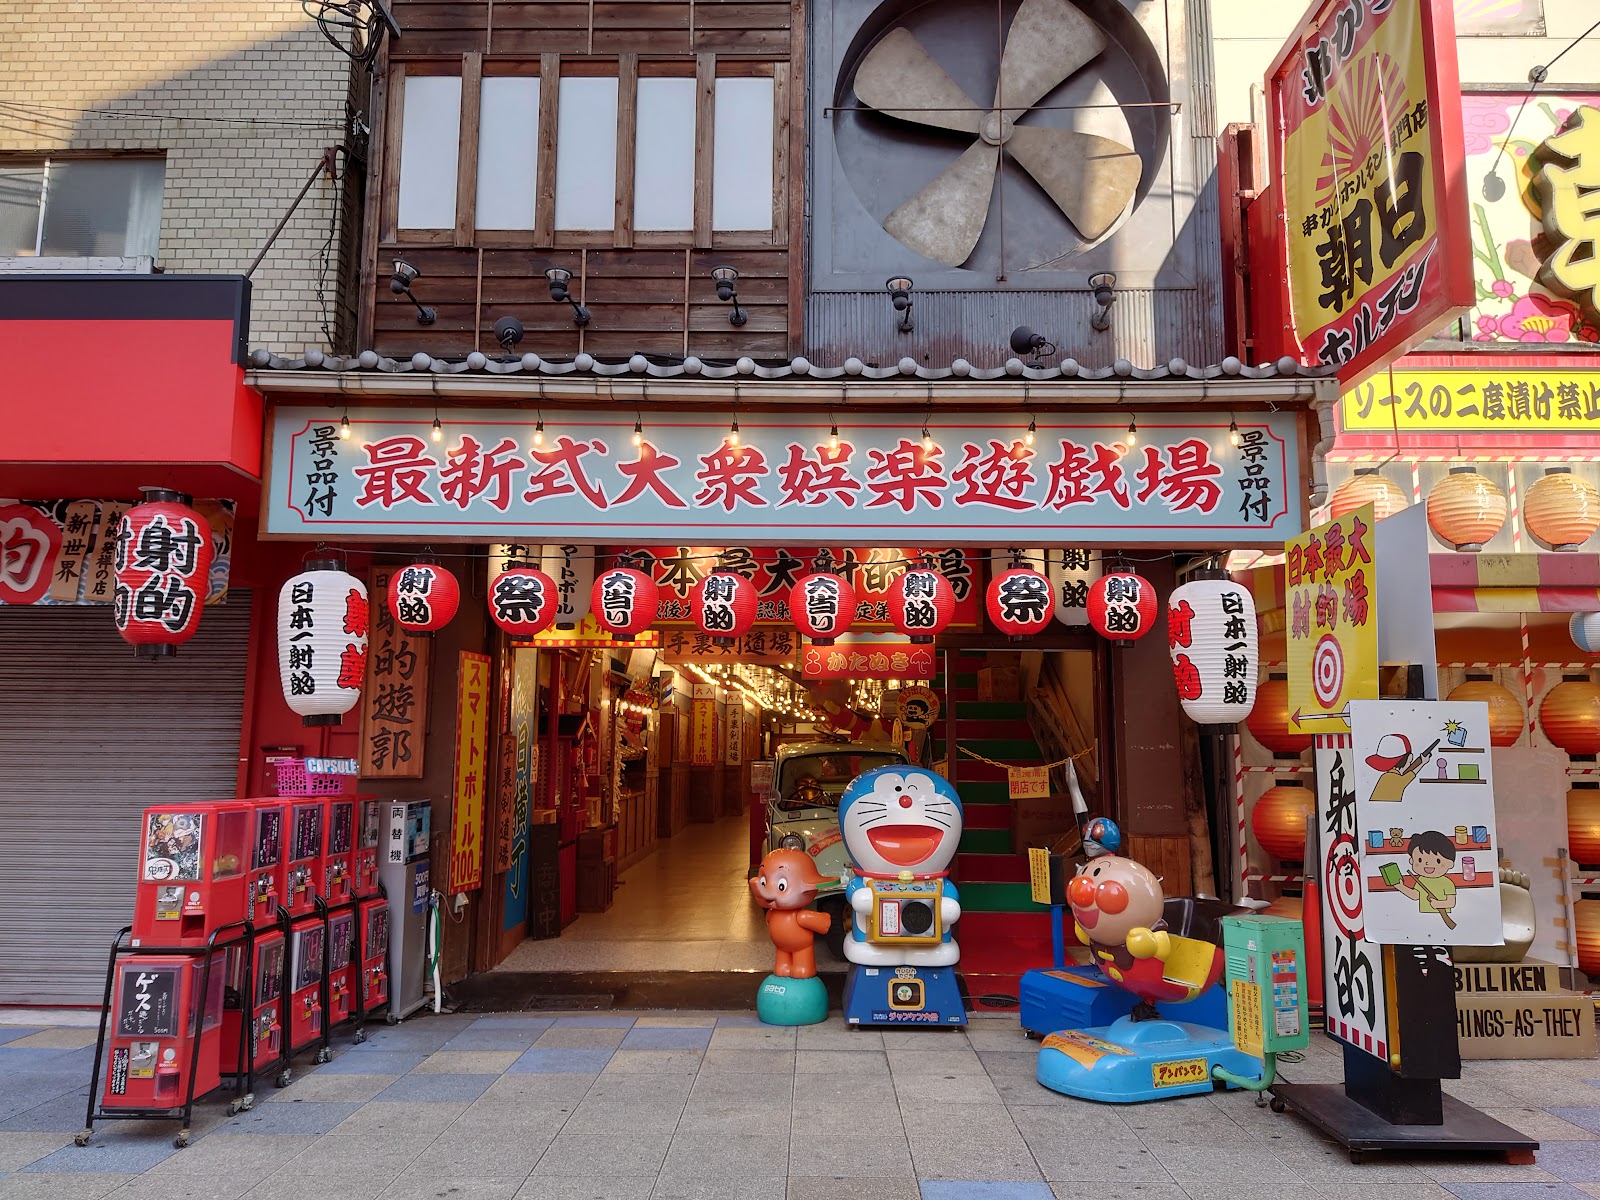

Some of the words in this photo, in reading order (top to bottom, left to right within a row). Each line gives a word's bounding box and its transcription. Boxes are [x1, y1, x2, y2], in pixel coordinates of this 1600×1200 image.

[1315, 151, 1426, 314] 朝日
[304, 425, 340, 517] 景品付
[353, 434, 1224, 515] 最新式大衆娯楽遊戯場
[1237, 430, 1271, 523] 景品付
[55, 512, 91, 583] 新世界
[134, 515, 203, 631] 射的
[1287, 515, 1372, 587] 日本最大
[399, 567, 435, 625] 射的
[494, 576, 544, 622] 祭
[603, 572, 635, 627] 大当り
[704, 576, 737, 631] 射的
[807, 577, 838, 631] 大当り
[904, 573, 937, 628] 射的
[1001, 575, 1049, 622] 祭
[1106, 577, 1140, 632] 射的
[1291, 568, 1369, 641] 射的場
[289, 581, 315, 695] 日本一射的
[827, 651, 910, 672] かたぬき
[1220, 591, 1248, 705] 日本一射的
[307, 758, 357, 774] CAPSULE
[461, 663, 482, 848] スマートボール
[498, 740, 514, 868] 手裏剣道場
[1010, 779, 1048, 794] 閉店です
[390, 807, 404, 862] 両替機
[454, 849, 480, 885] 100円
[1454, 966, 1547, 992] BILLIKEN
[1158, 1064, 1203, 1081] アンパンマン
